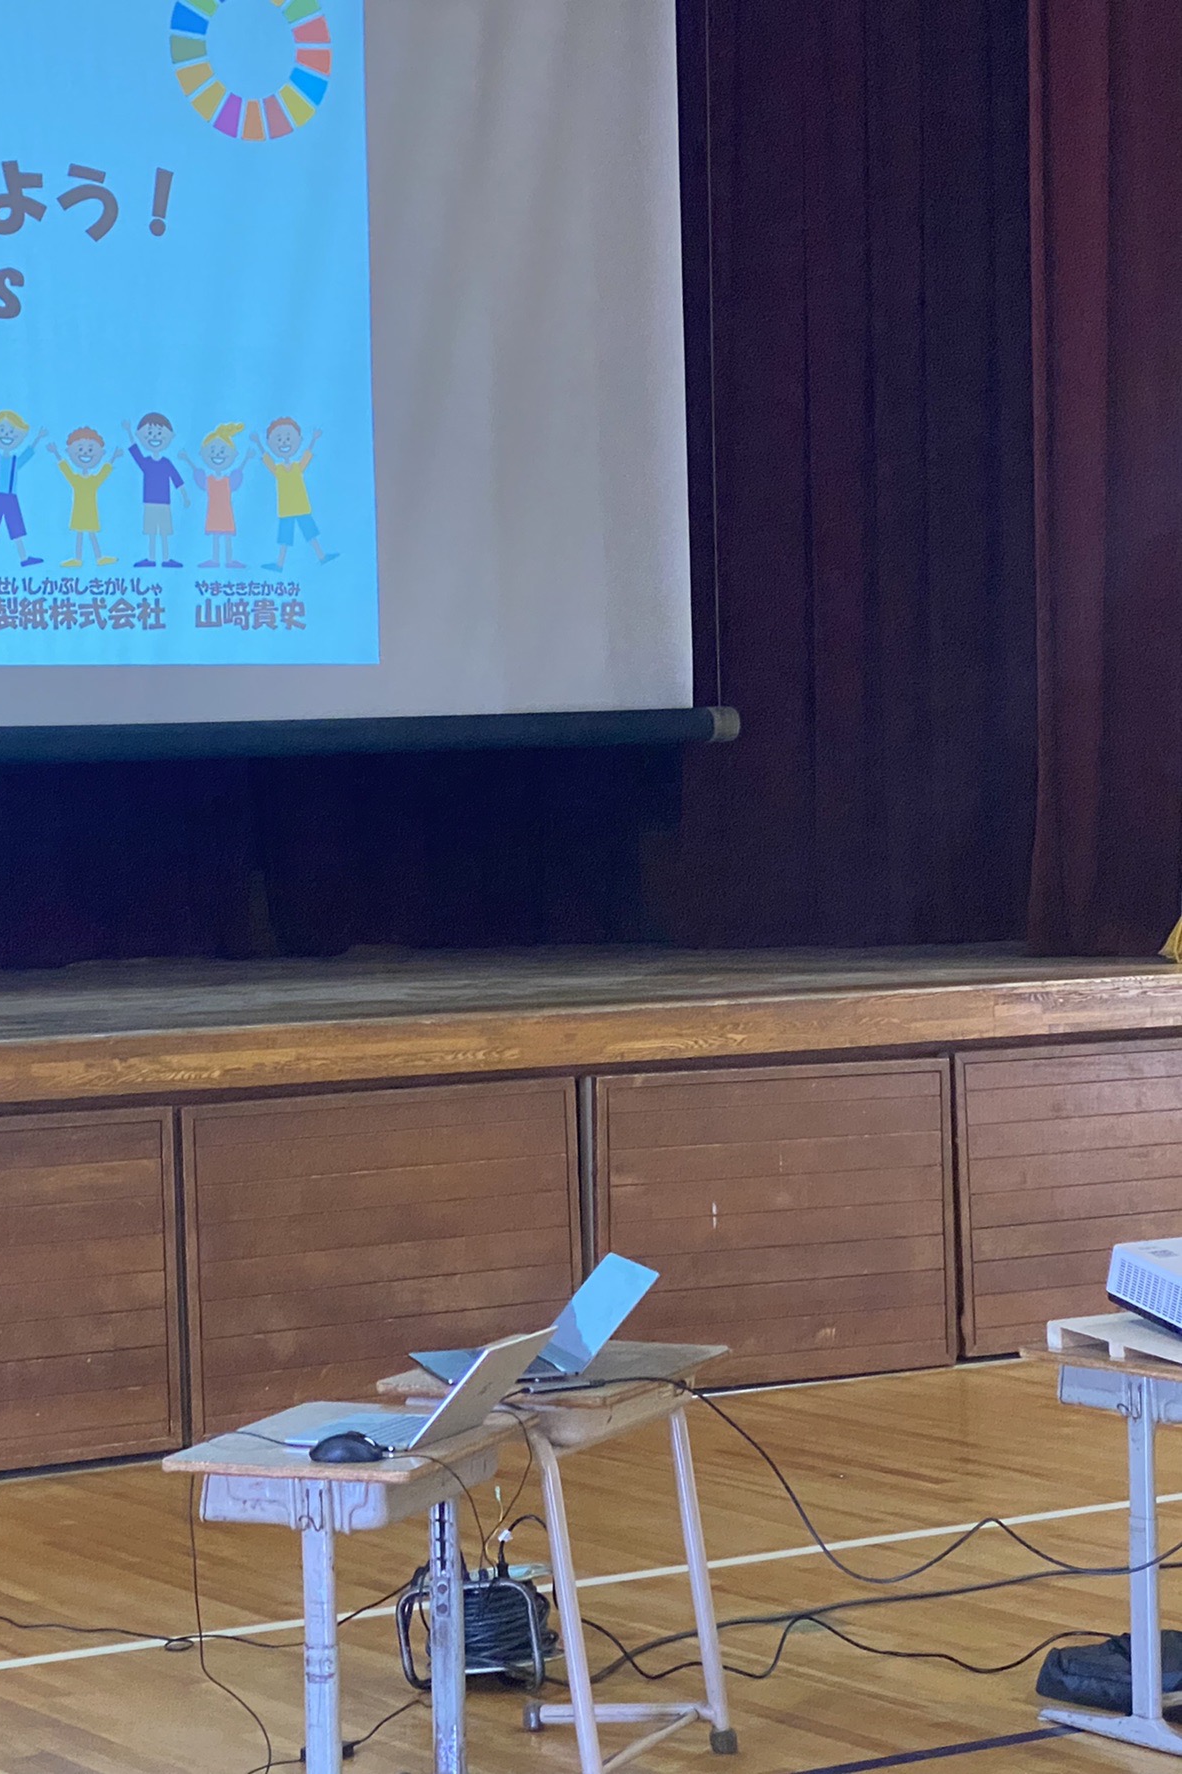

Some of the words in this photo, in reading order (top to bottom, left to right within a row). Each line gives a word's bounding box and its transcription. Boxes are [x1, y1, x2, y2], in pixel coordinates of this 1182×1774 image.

[194, 580, 301, 597] やまさきたかふみ
